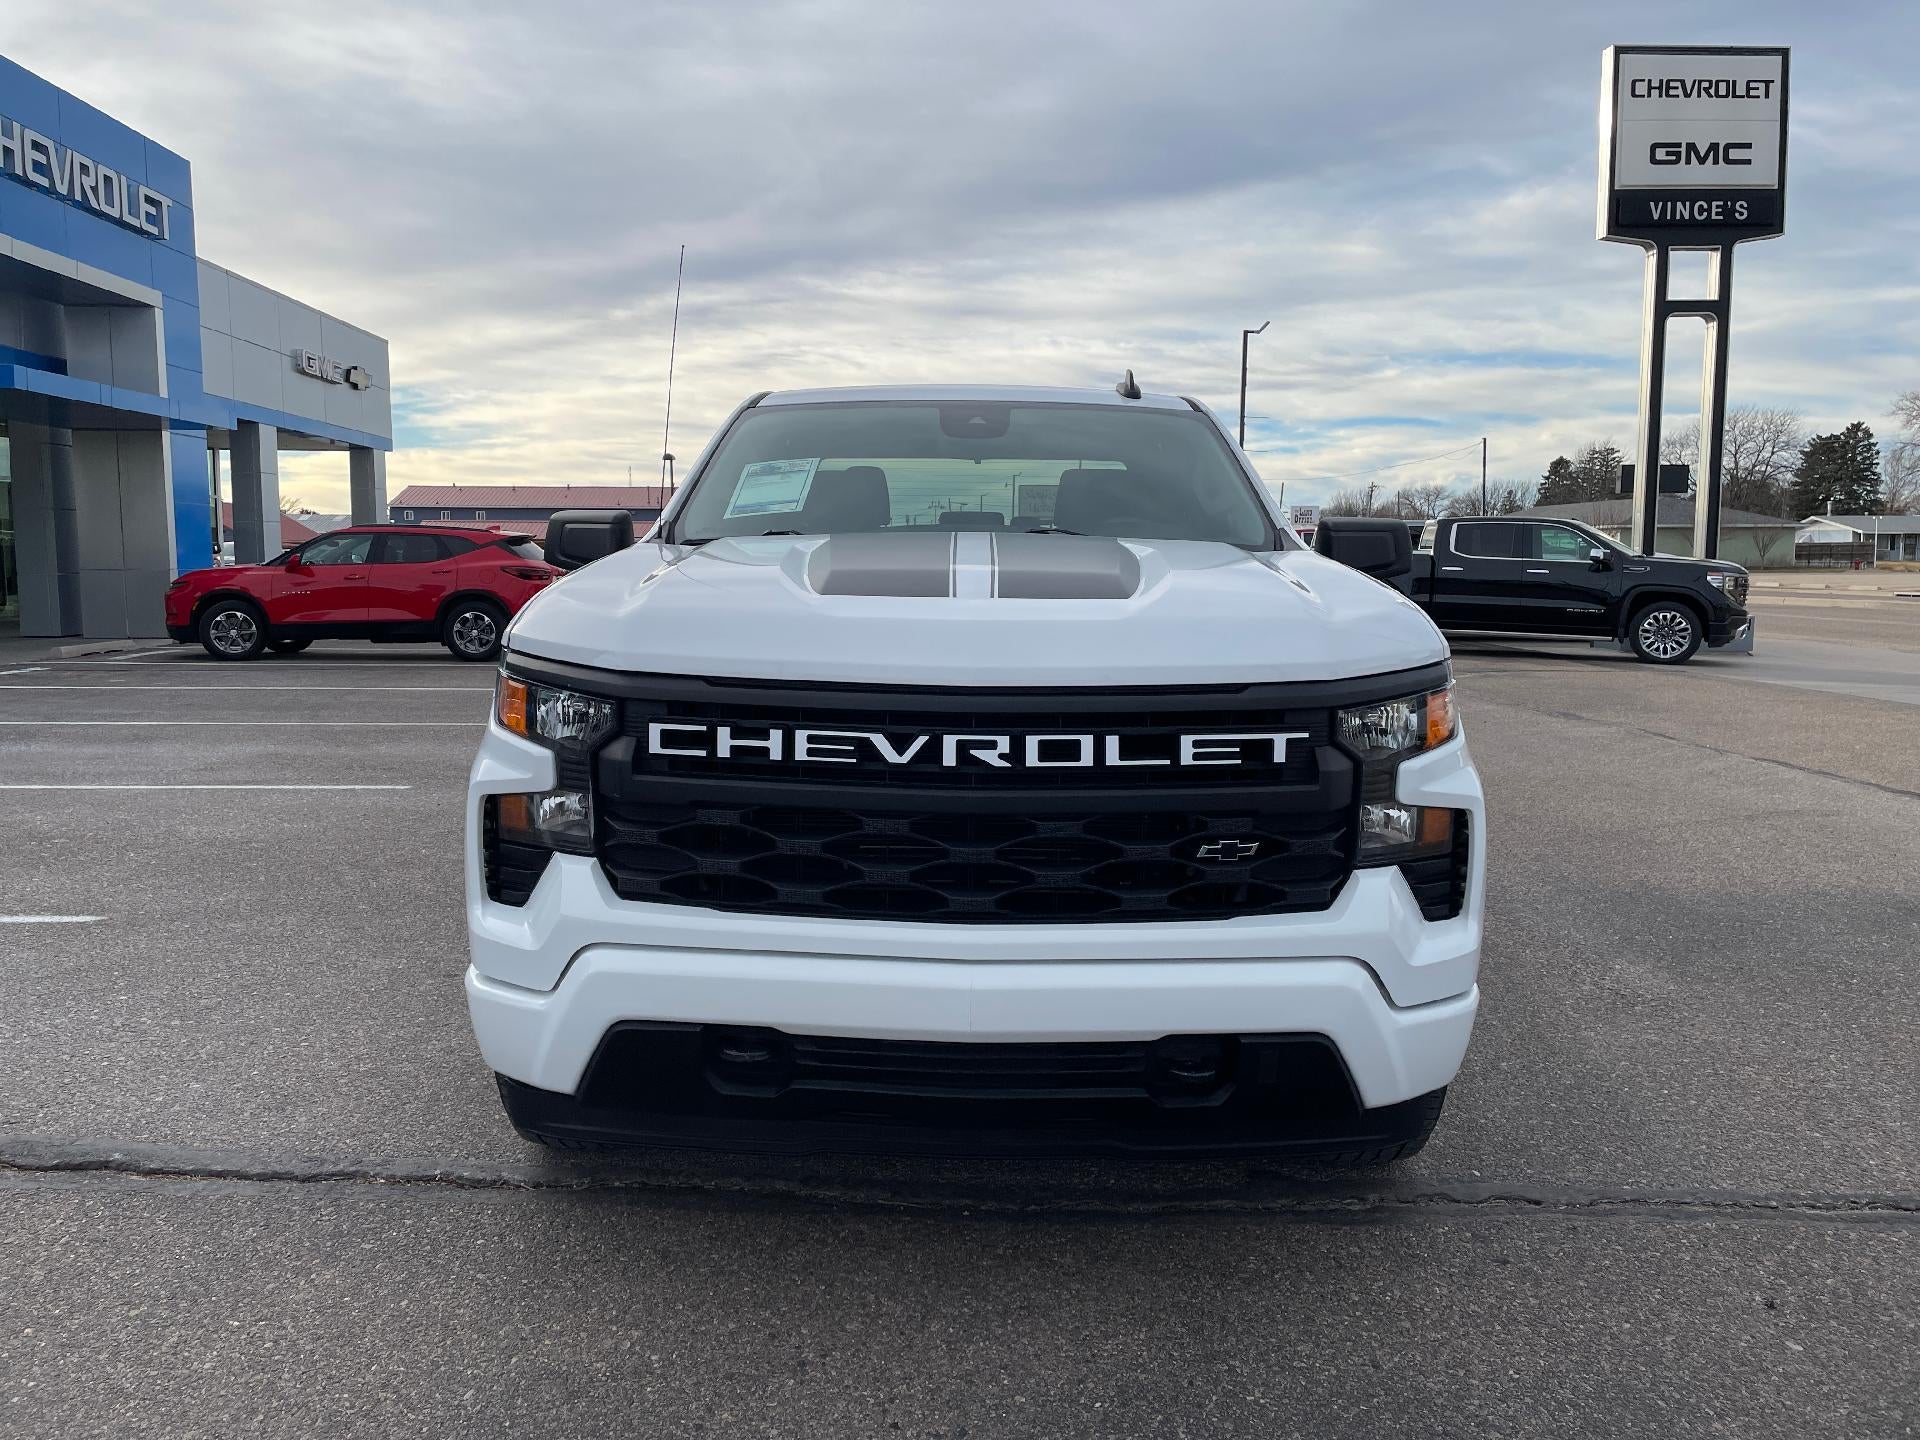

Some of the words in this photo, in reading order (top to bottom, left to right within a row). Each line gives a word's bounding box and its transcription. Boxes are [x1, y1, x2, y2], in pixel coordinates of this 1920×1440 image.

[1631, 78, 1775, 99] CHEVROLET
[1649, 142, 1753, 166] GMC
[1650, 200, 1749, 221] VINCE'S
[302, 349, 344, 384] GMC
[648, 722, 1309, 768] CHEVROLET
